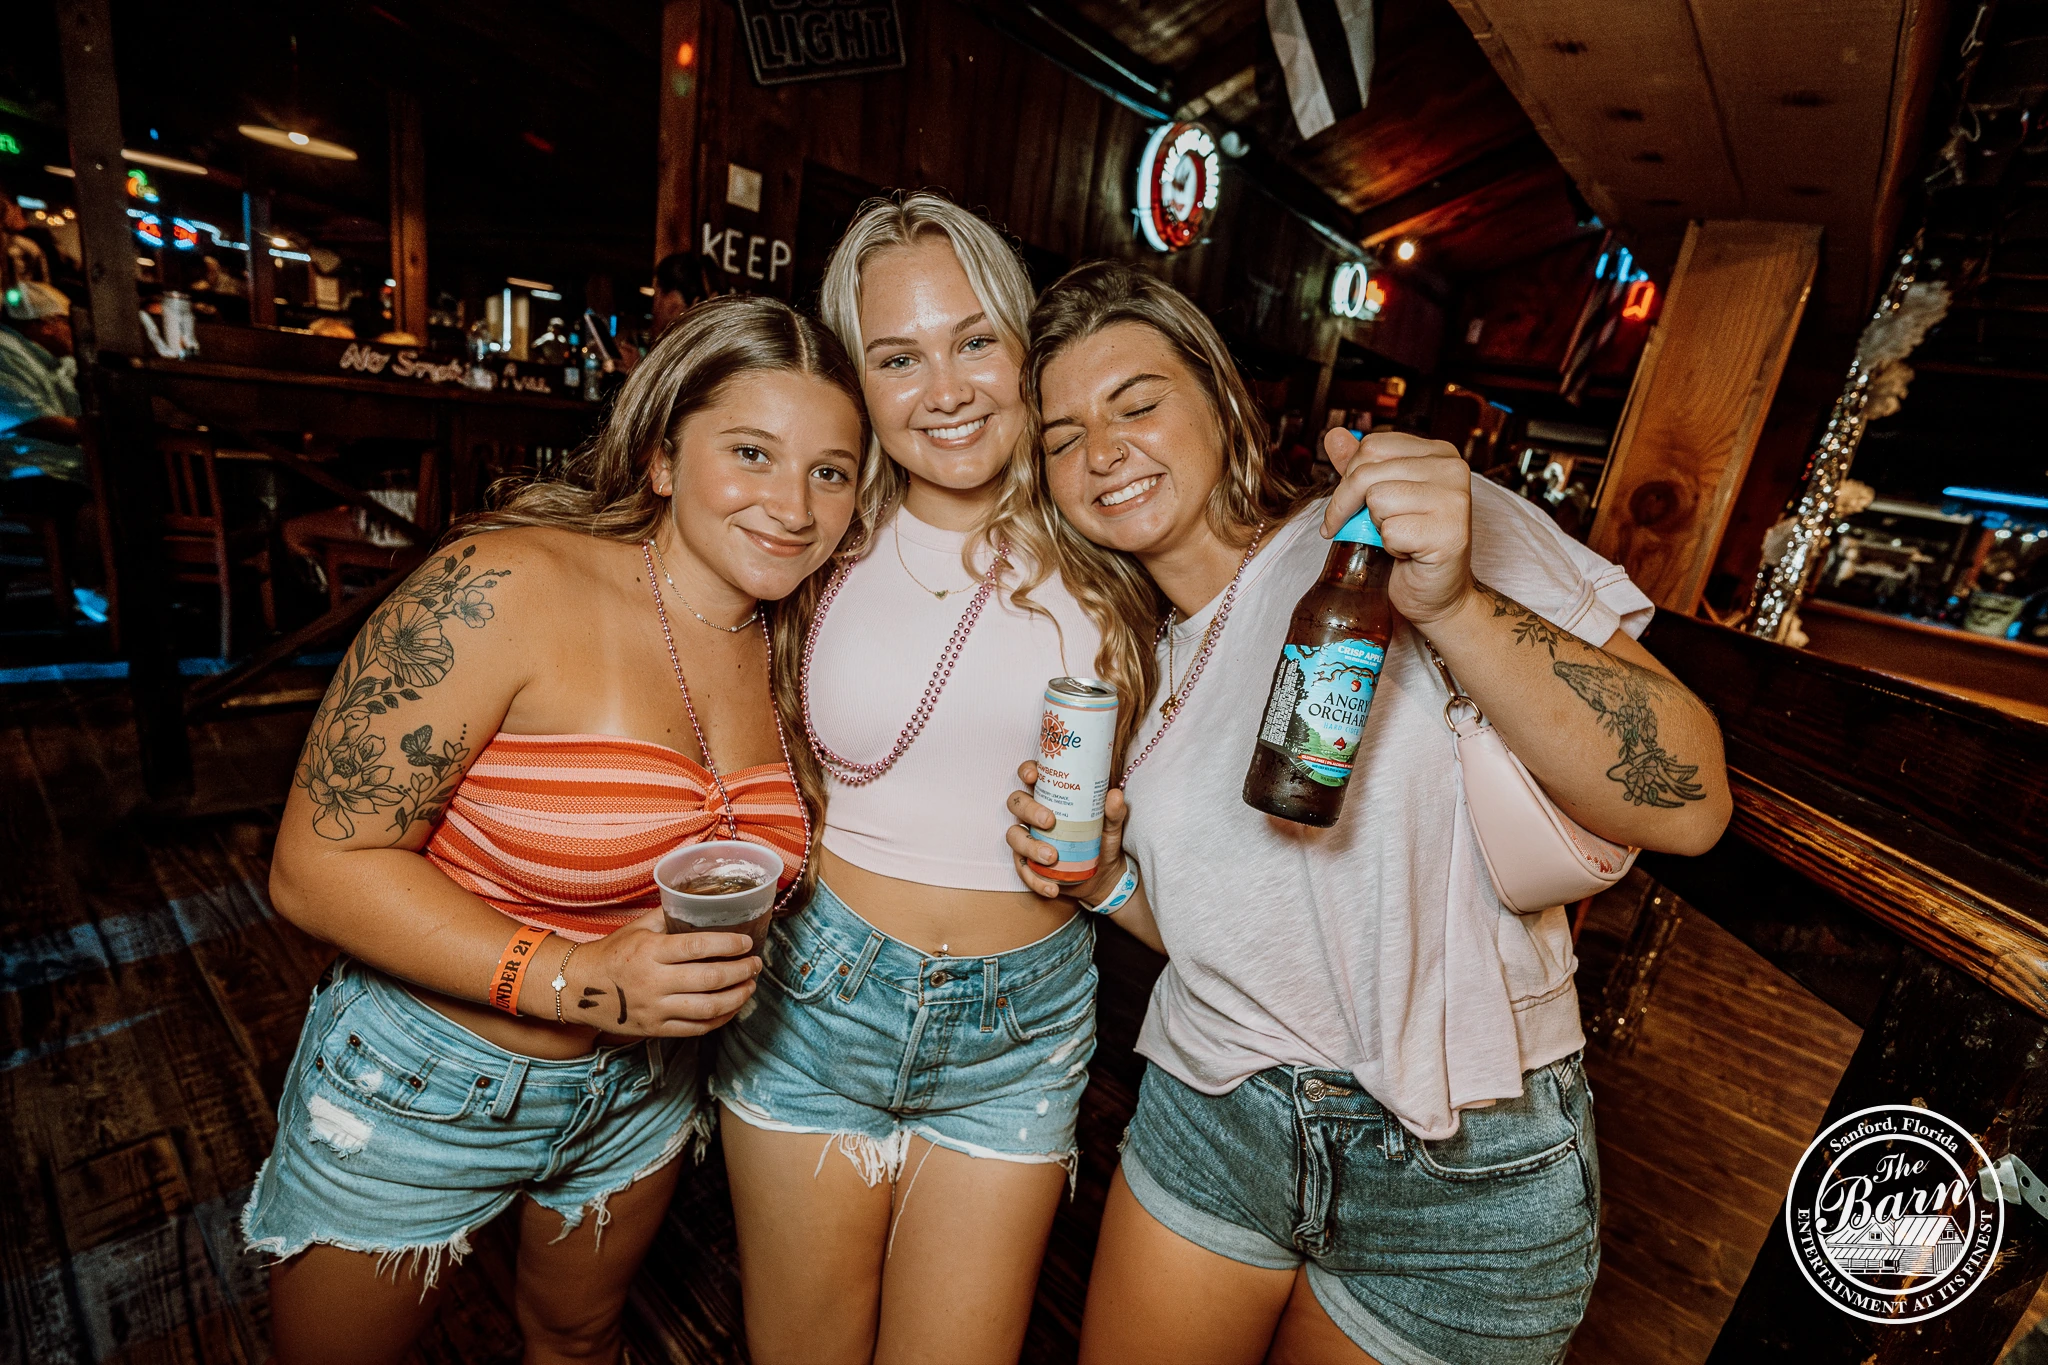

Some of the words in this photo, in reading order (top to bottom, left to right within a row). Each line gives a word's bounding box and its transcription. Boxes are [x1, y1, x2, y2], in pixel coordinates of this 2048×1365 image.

[752, 7, 892, 69] LIGHT
[702, 222, 792, 282] KEEP
[339, 343, 391, 374] No
[1337, 645, 1365, 657] CRISP
[1364, 651, 1383, 663] APPLE
[1324, 691, 1371, 713] ANGRY
[1043, 725, 1082, 749] rfside
[1323, 721, 1343, 731] HARD
[1037, 763, 1070, 780] AWBERRY
[1052, 779, 1081, 791] VODKA
[496, 960, 521, 1009] UNDER
[513, 939, 533, 956] 21
